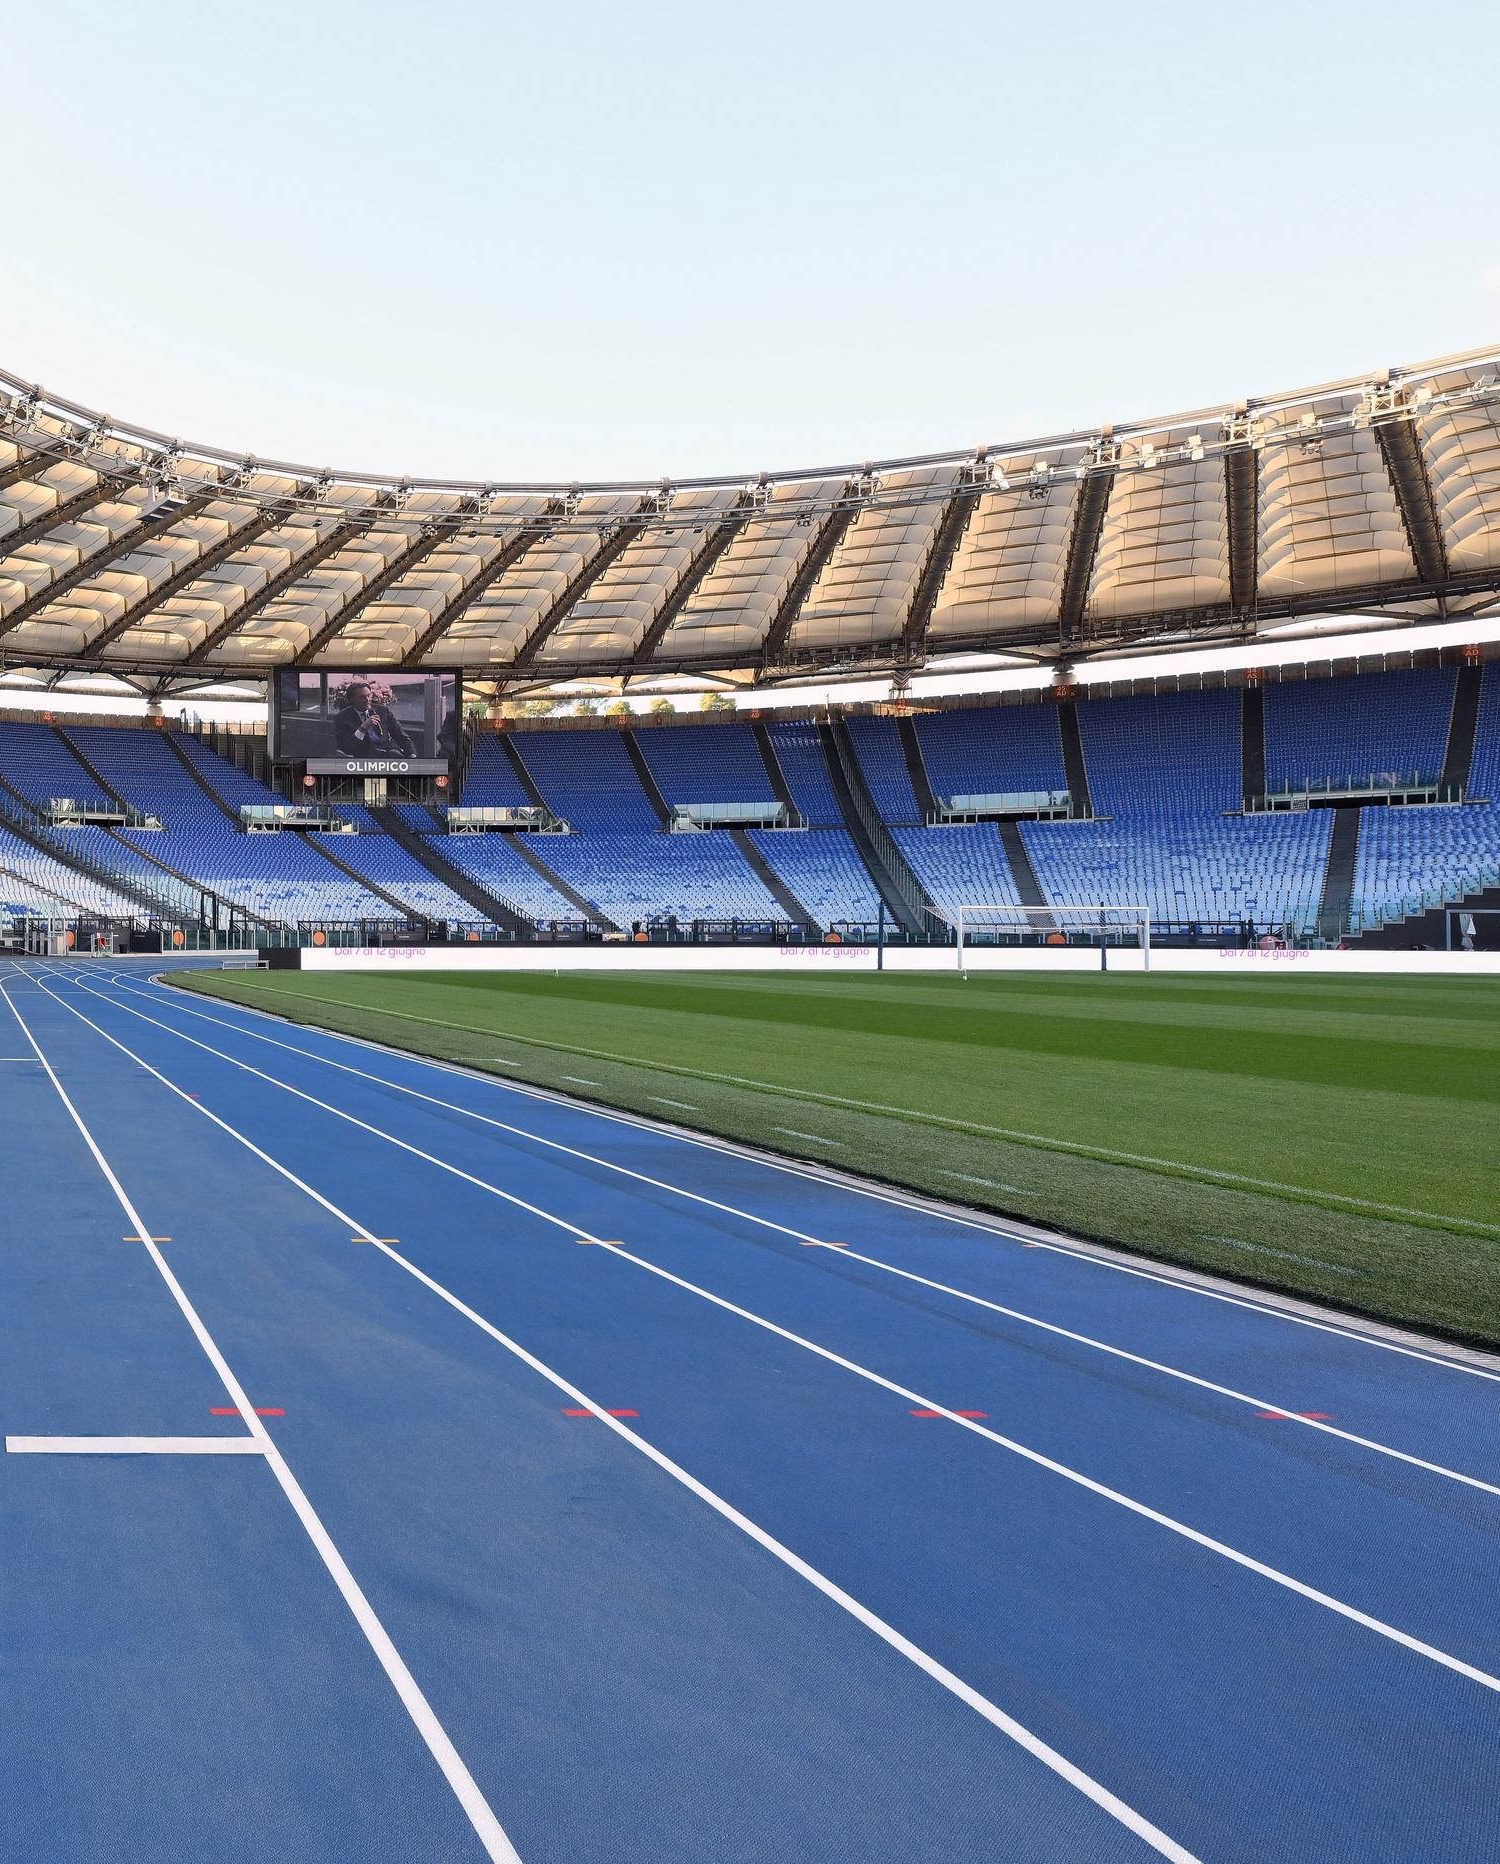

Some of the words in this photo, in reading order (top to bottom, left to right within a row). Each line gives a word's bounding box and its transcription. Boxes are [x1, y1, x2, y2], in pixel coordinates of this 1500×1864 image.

[346, 762, 408, 772] OLIMPICO
[388, 948, 426, 958] giugno
[833, 948, 870, 958] giugno
[1272, 950, 1309, 960] giugno
